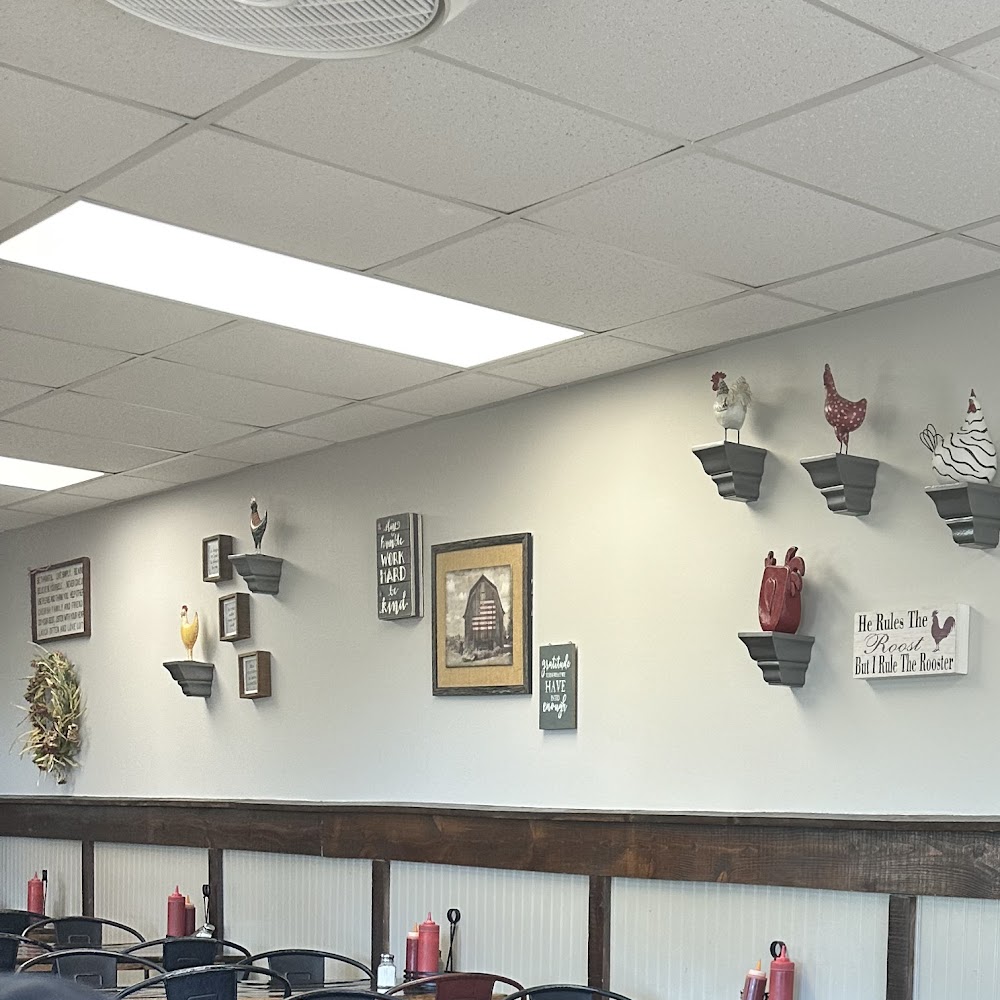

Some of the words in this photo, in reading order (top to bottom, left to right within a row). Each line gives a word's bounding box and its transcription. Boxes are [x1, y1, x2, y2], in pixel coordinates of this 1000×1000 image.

[381, 551, 405, 567] WORK
[380, 566, 406, 584] HARD
[388, 584, 400, 597] be
[379, 590, 408, 615] kind
[858, 614, 872, 632] He
[876, 612, 904, 631] Rules
[908, 610, 928, 629] The
[864, 633, 925, 655] Roost
[855, 656, 870, 675] But
[872, 655, 876, 674] I
[878, 654, 898, 674] Rule
[901, 653, 917, 672] The
[920, 652, 954, 672] Rooster
[545, 680, 567, 694] HAVE
